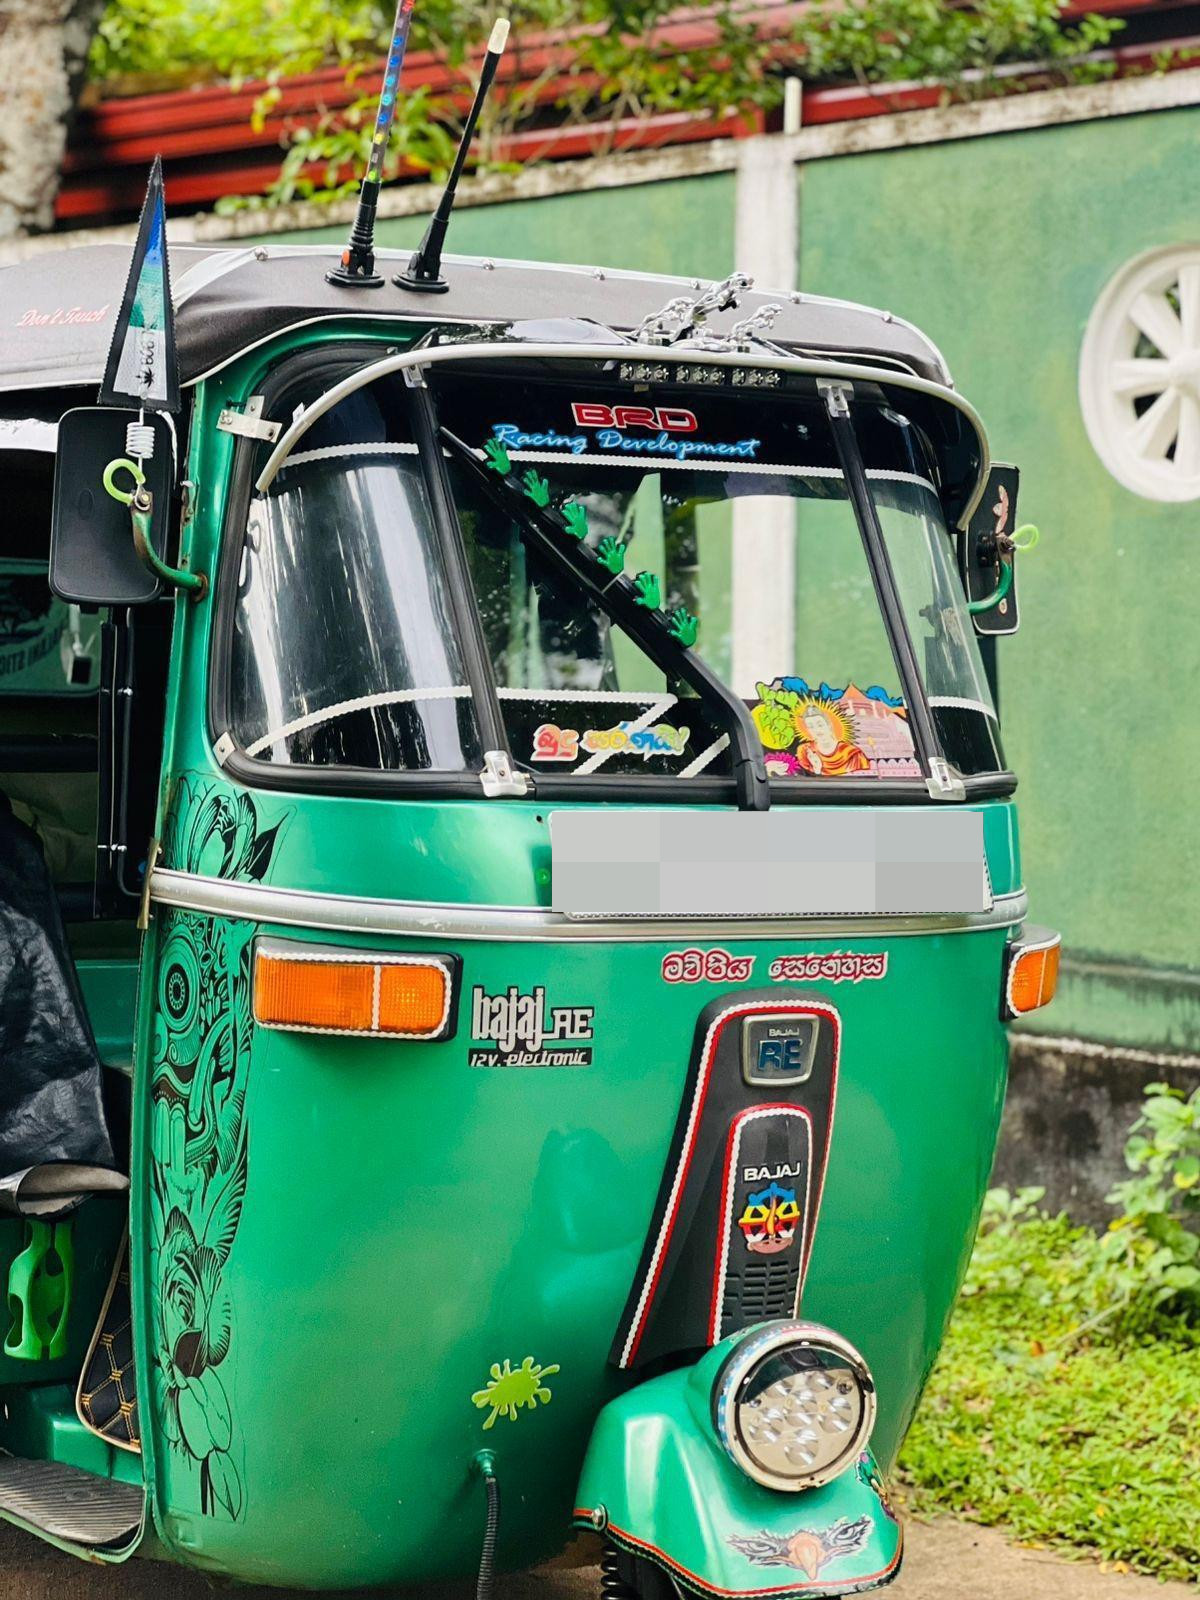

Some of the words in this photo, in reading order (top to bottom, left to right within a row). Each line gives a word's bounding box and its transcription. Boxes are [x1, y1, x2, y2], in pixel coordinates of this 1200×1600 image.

[571, 402, 698, 432] BRD
[491, 423, 588, 455] Racing
[596, 427, 761, 461] Development
[768, 1027, 800, 1038] BAJAJ
[757, 1039, 803, 1072] RE
[743, 1162, 801, 1182] BAJAJ
